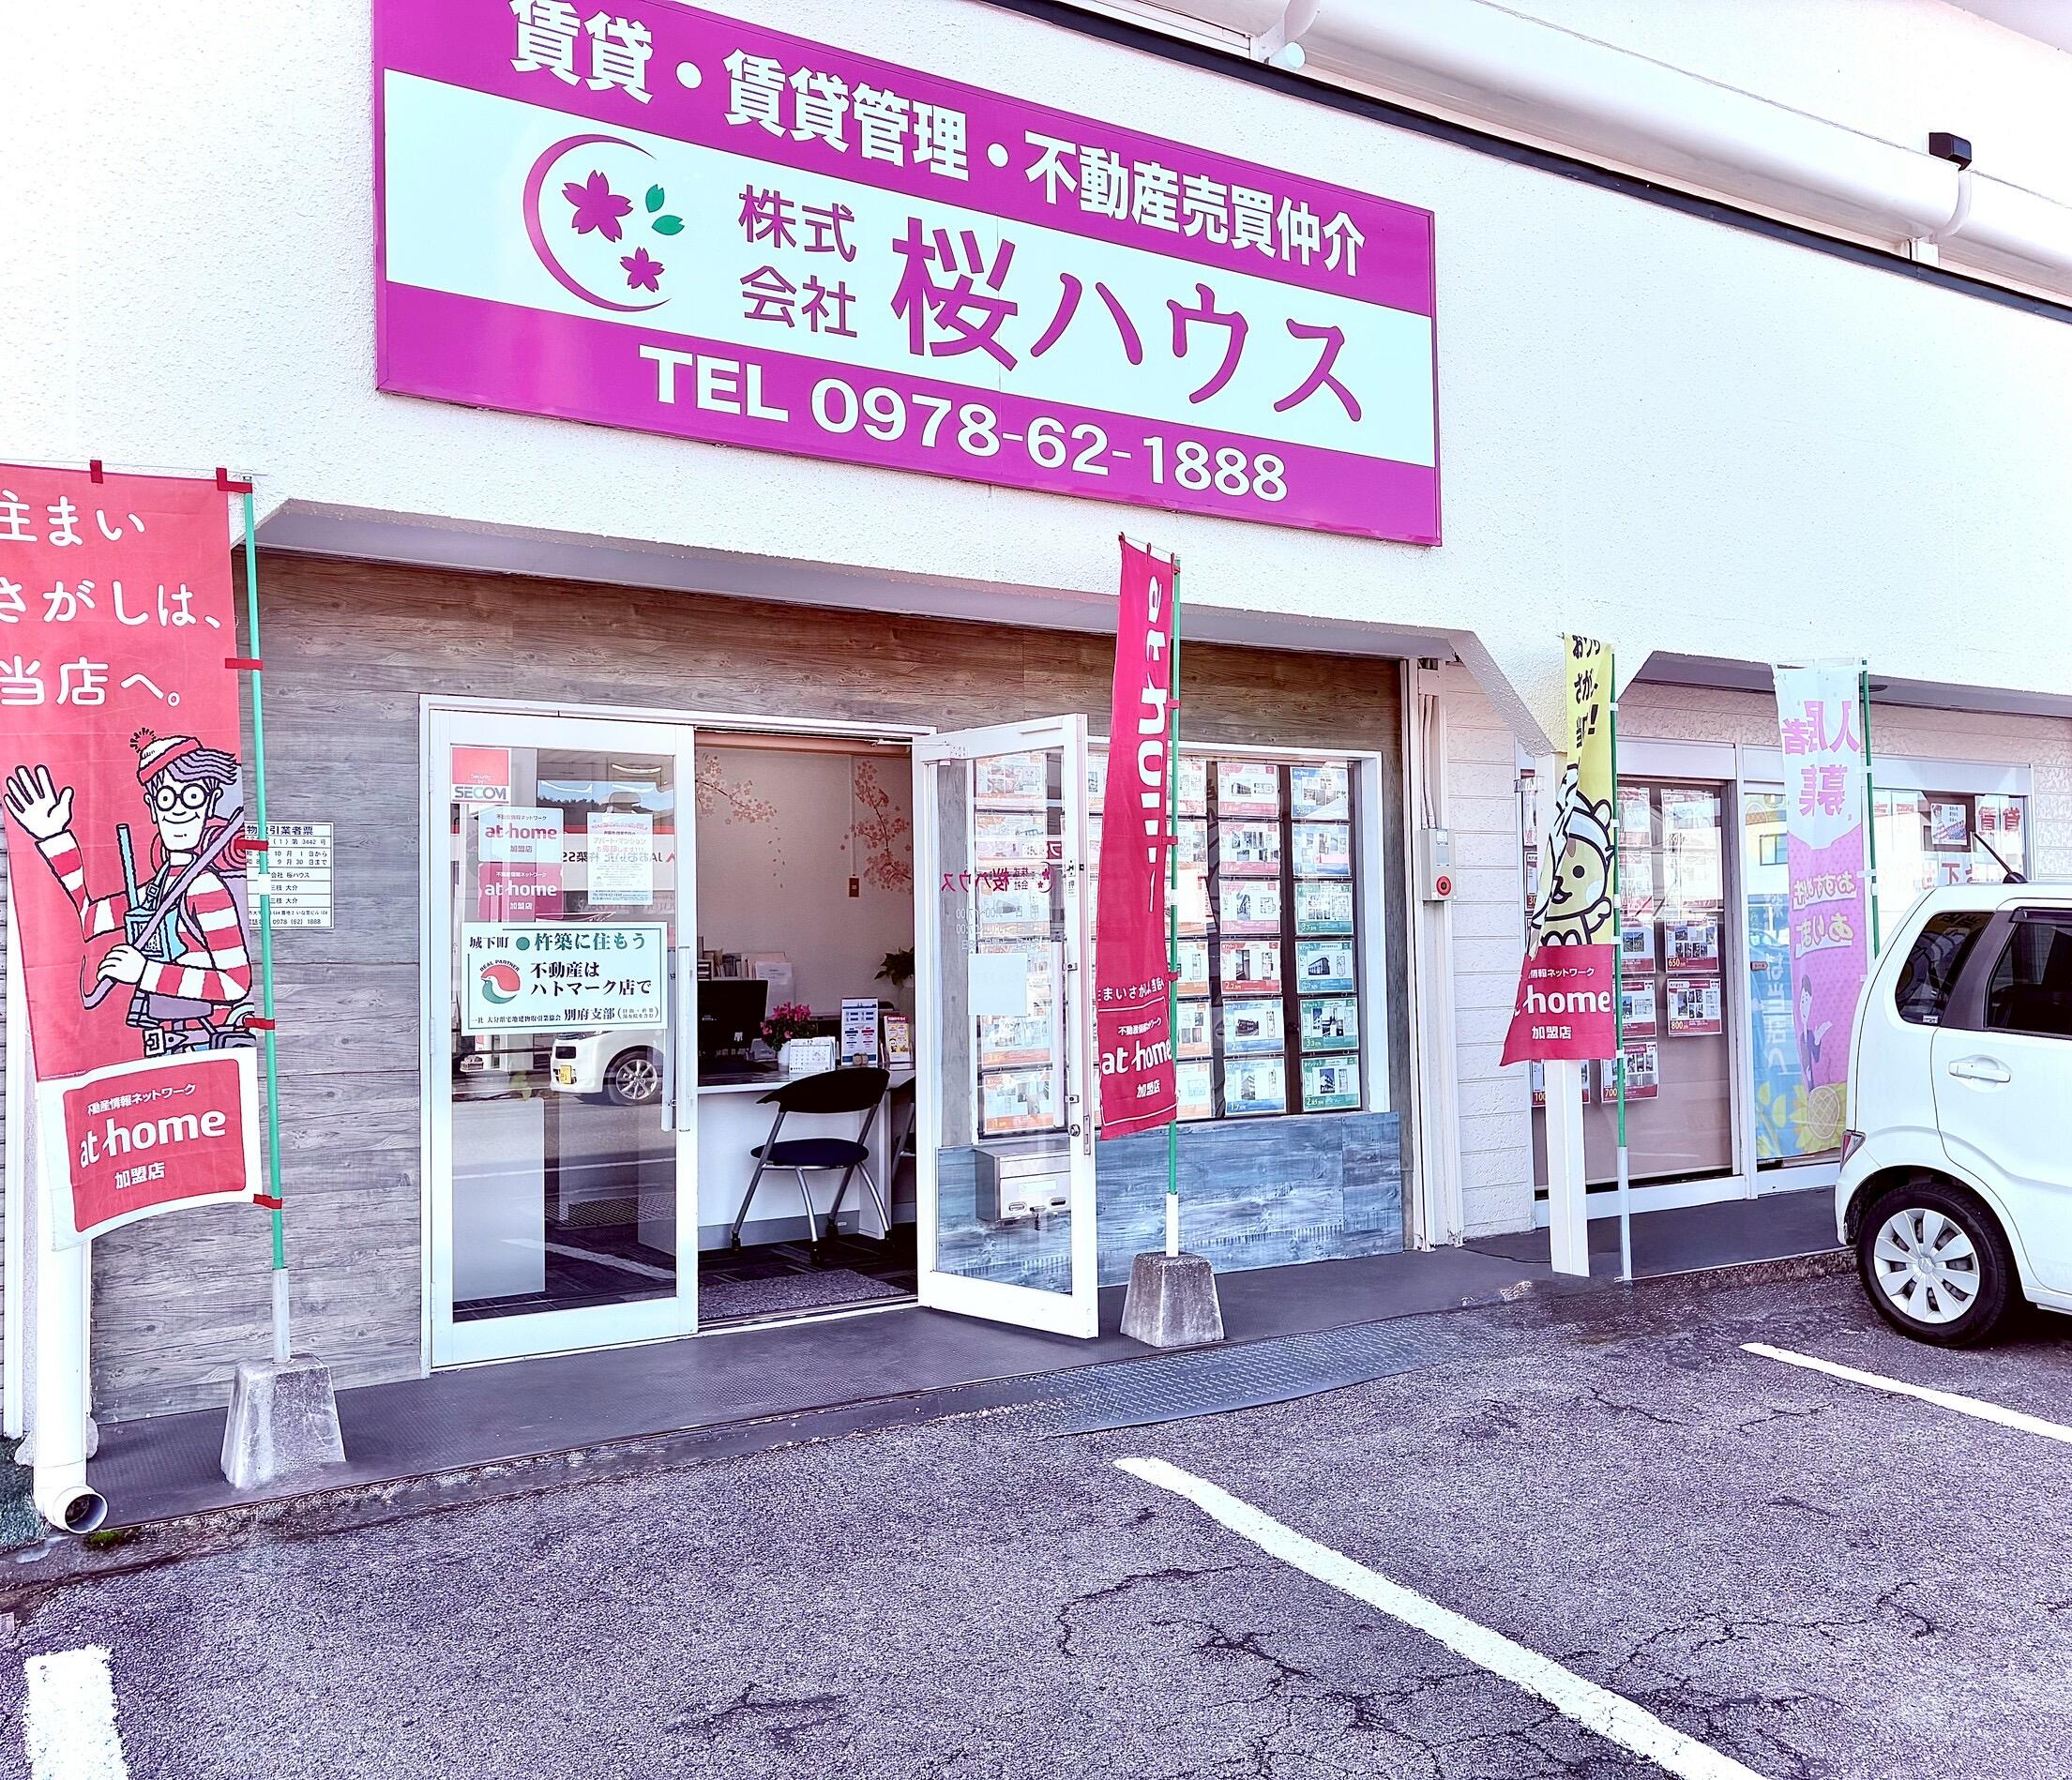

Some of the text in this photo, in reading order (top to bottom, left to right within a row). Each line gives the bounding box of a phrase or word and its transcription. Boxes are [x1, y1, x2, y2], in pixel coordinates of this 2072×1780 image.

[738, 184, 857, 263] 株式
[739, 264, 857, 338] 会社
[890, 217, 1363, 422] 桜ハウス
[639, 344, 1288, 503] TEL 0978-62-1888
[0, 655, 180, 706] 当店へ。
[454, 786, 507, 800] SECOM
[485, 822, 557, 840] at home
[484, 879, 557, 897] at home
[469, 936, 509, 949] 城下町
[534, 932, 645, 951] 杵築に住もう
[479, 959, 521, 972] REAL PARTNER
[530, 961, 600, 978] 不動産は
[530, 979, 652, 997] ハトマーク店で
[1522, 985, 1611, 1014] home
[1531, 1025, 1572, 1040] 加盟店
[1101, 1039, 1173, 1076] at home
[79, 1109, 227, 1169] at home
[114, 1162, 165, 1190] 加盟店
